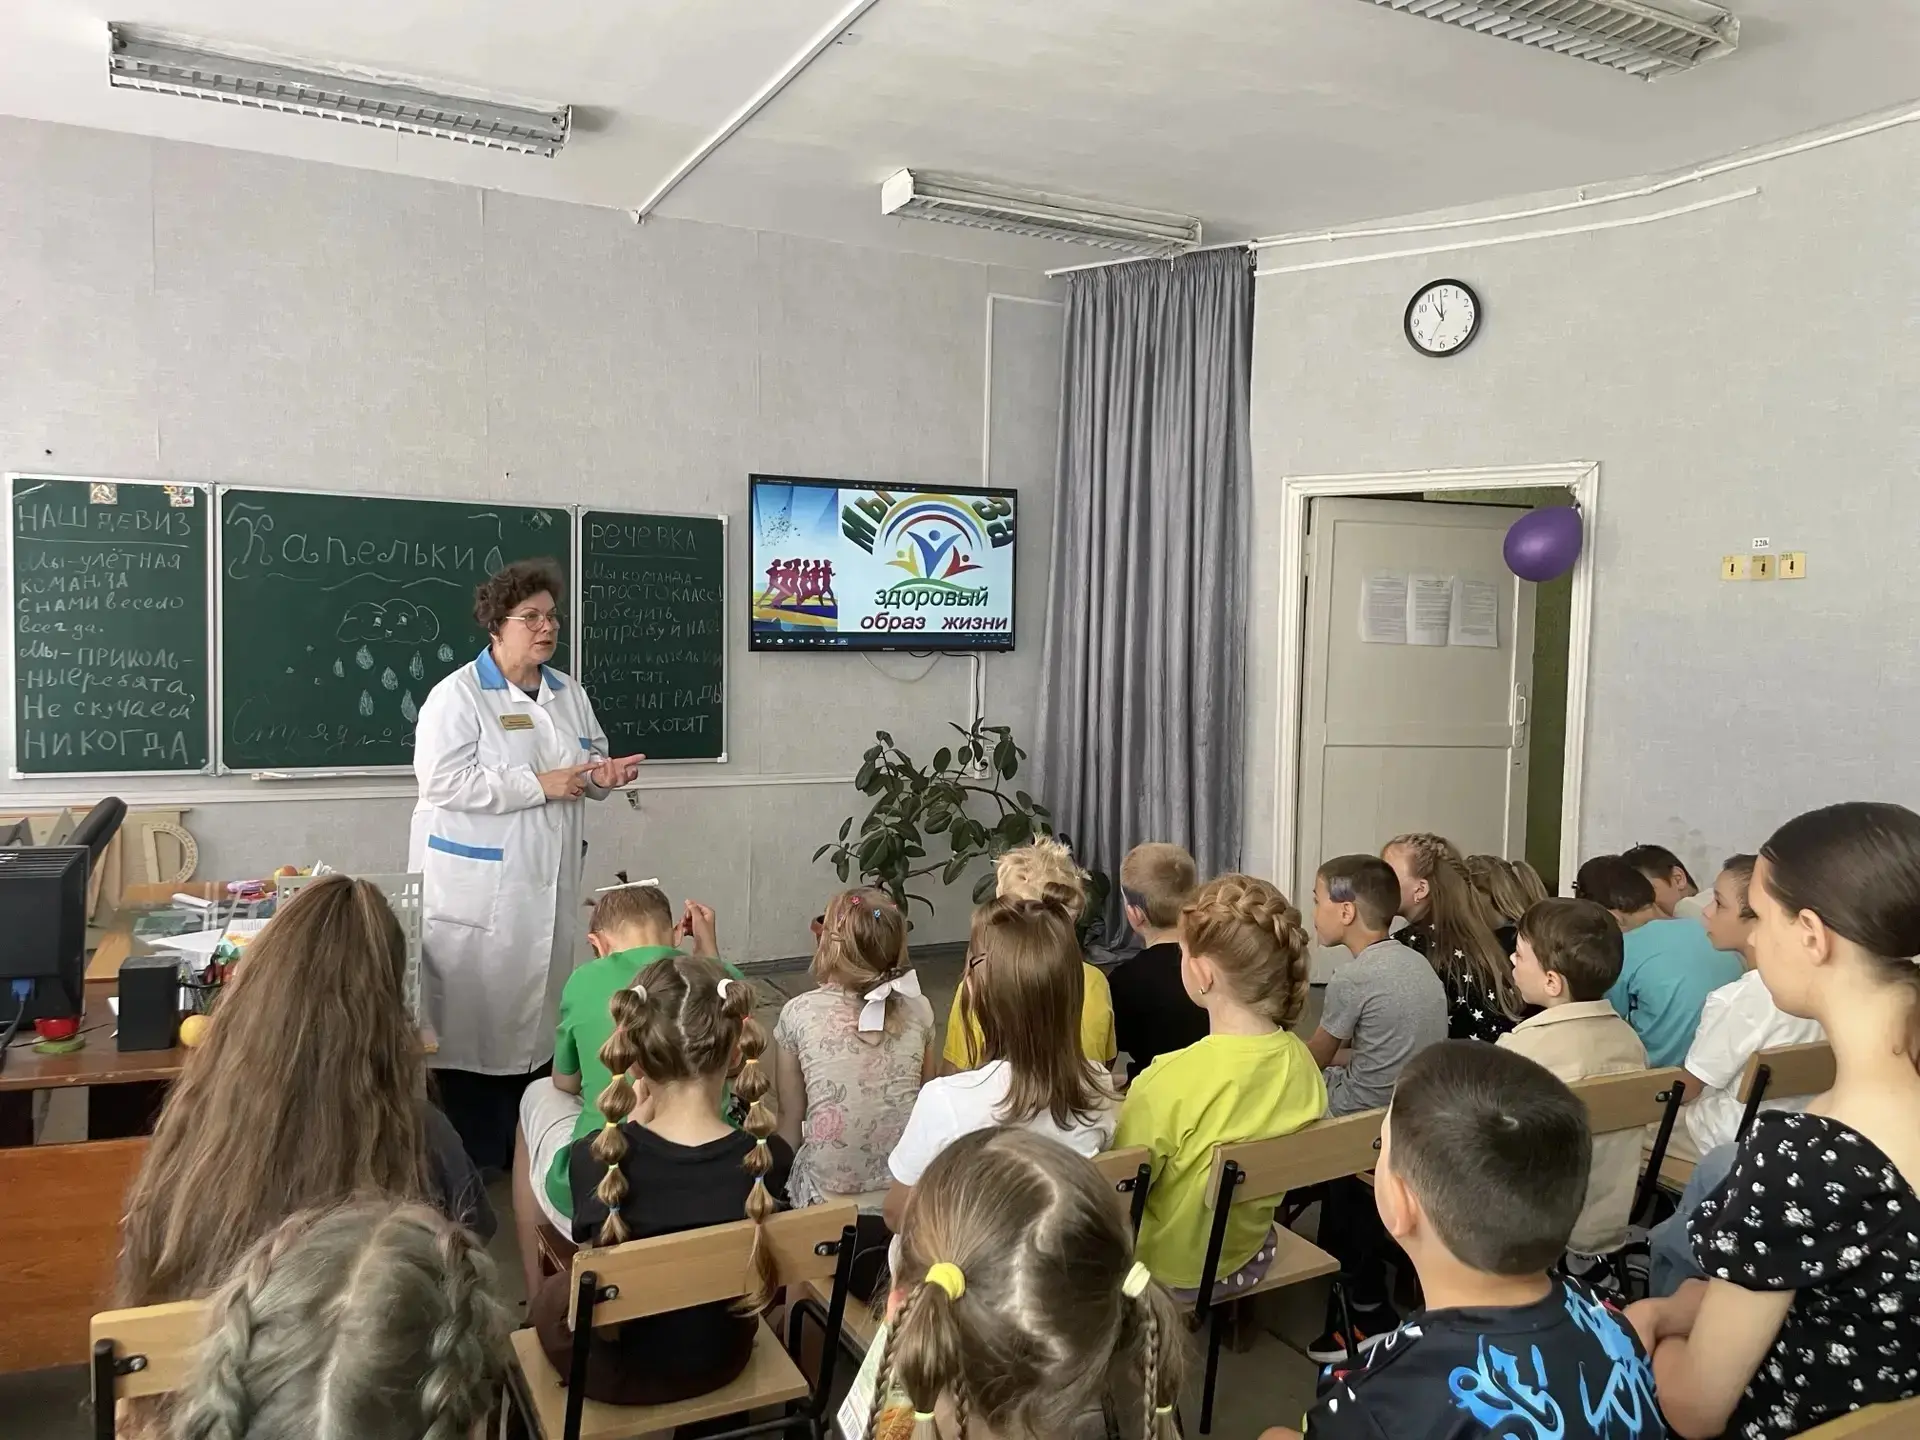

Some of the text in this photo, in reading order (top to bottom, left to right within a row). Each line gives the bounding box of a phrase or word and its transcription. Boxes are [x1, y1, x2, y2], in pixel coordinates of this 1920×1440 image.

[1427, 293, 1435, 303] 11
[1463, 298, 1469, 307] 2
[1419, 304, 1428, 313] 10
[1467, 311, 1473, 320] 3
[1413, 319, 1420, 327] 9
[1463, 325, 1469, 333] 4
[1418, 330, 1424, 339] 8
[1439, 340, 1446, 349] 6
[1453, 336, 1459, 345] 5
[19, 503, 191, 536] НАШ ДЕВИЗ
[227, 503, 475, 580] Капельки
[105, 592, 185, 610] весело
[874, 587, 988, 609] здоровый
[860, 612, 1008, 632] образ жизни
[24, 694, 61, 720] Не
[24, 728, 189, 765] НИКОГДА
